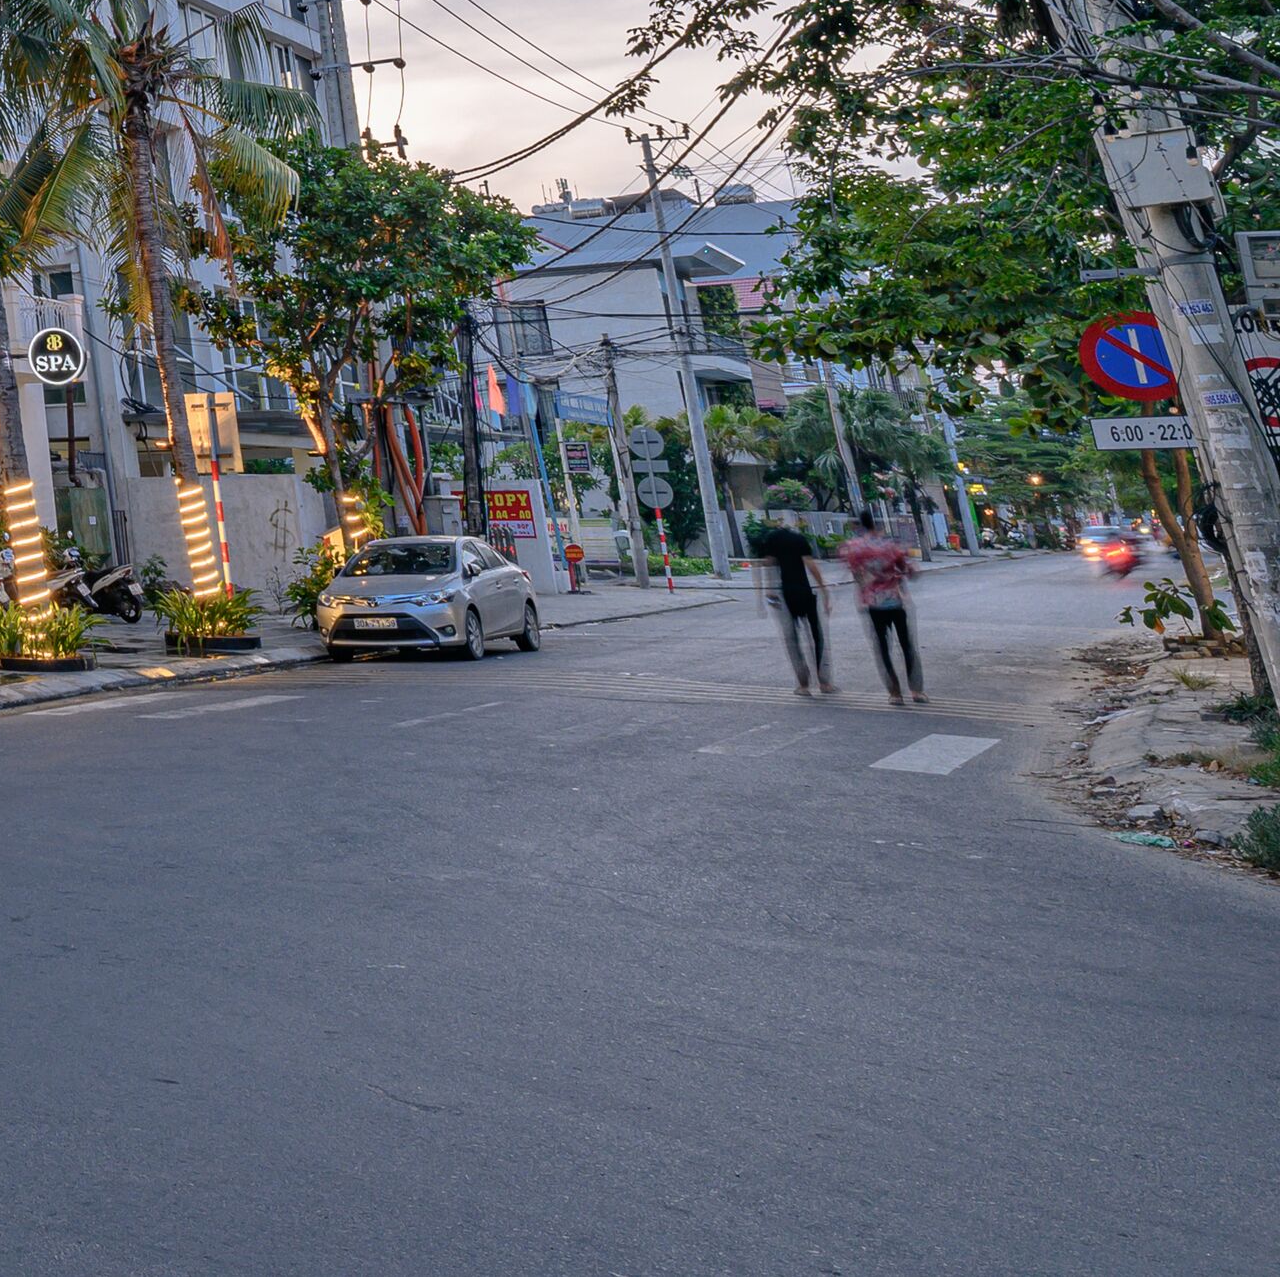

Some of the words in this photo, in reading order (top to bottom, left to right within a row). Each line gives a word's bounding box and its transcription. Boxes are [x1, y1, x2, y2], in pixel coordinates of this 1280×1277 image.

[35, 354, 78, 373] SPA
[1110, 425, 1144, 443] 6:00
[1157, 423, 1193, 441] 22:0
